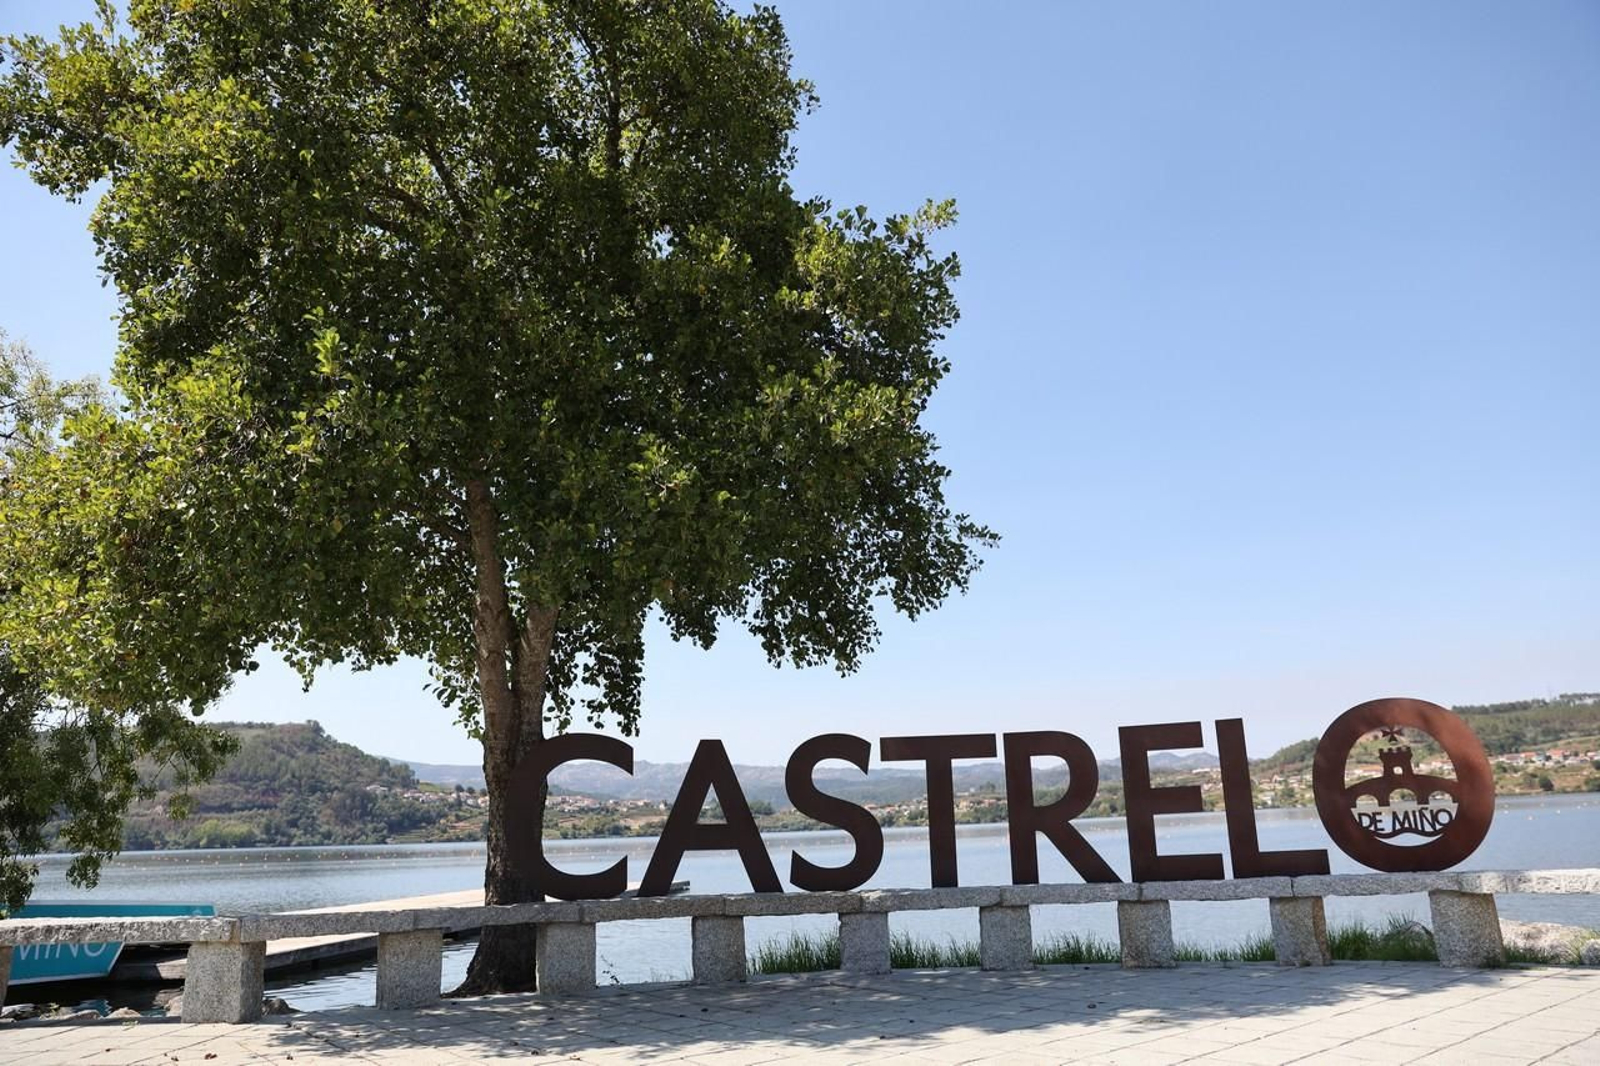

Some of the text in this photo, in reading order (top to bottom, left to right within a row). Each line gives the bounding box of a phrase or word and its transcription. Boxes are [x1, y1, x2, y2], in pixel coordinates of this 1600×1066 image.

[505, 698, 1495, 900] CASTRELO
[1358, 807, 1452, 832] DE MIÑO
